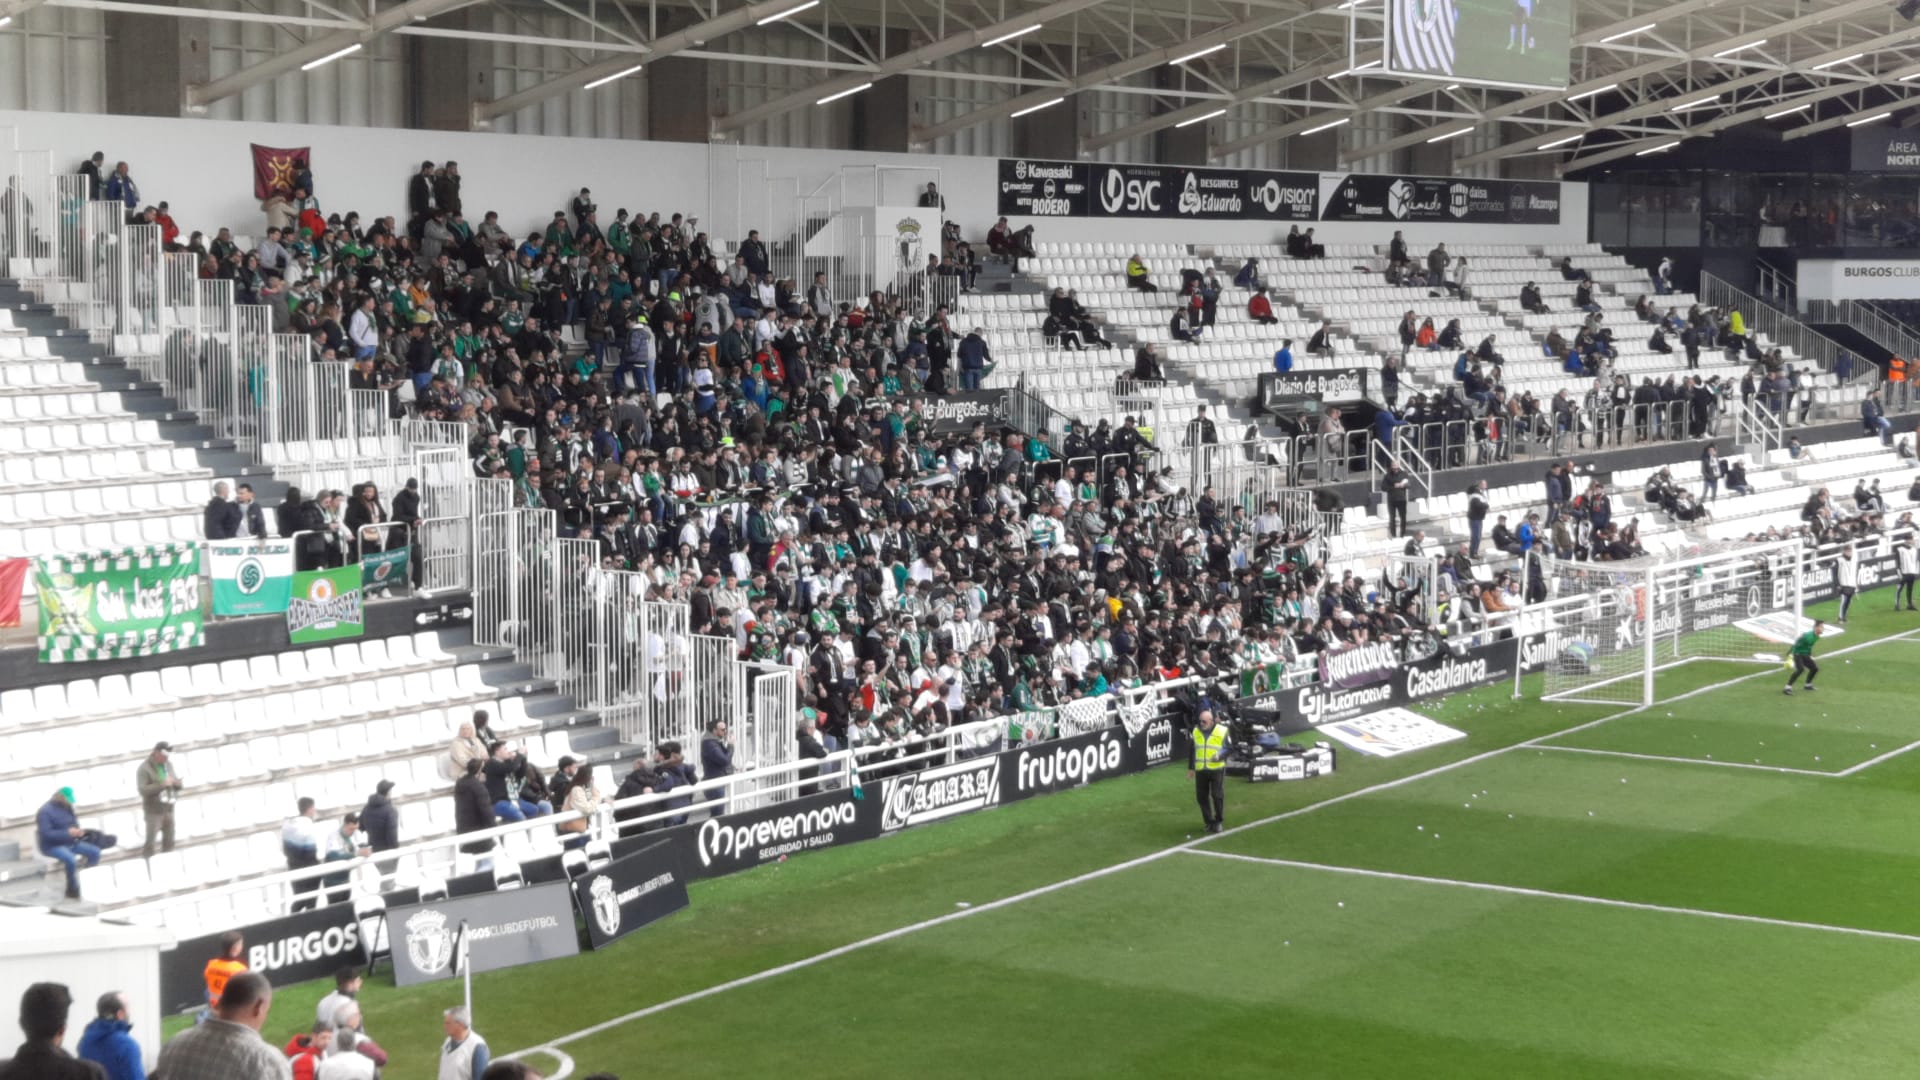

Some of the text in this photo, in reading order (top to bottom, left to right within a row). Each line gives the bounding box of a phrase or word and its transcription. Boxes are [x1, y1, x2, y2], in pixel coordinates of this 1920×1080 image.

[1888, 139, 1918, 153] ÁREA
[1028, 164, 1073, 179] Kawasaki
[1032, 199, 1070, 215] BODERO
[1127, 180, 1161, 211] SYC
[1202, 194, 1242, 213] Eduardo
[1275, 376, 1303, 395] Diario
[1304, 374, 1317, 393] de
[1407, 658, 1486, 698] Casablanca
[735, 801, 856, 860] prevennova
[759, 832, 834, 860] SEGURIDAD Y SALUD
[249, 922, 358, 974] BURGOS
